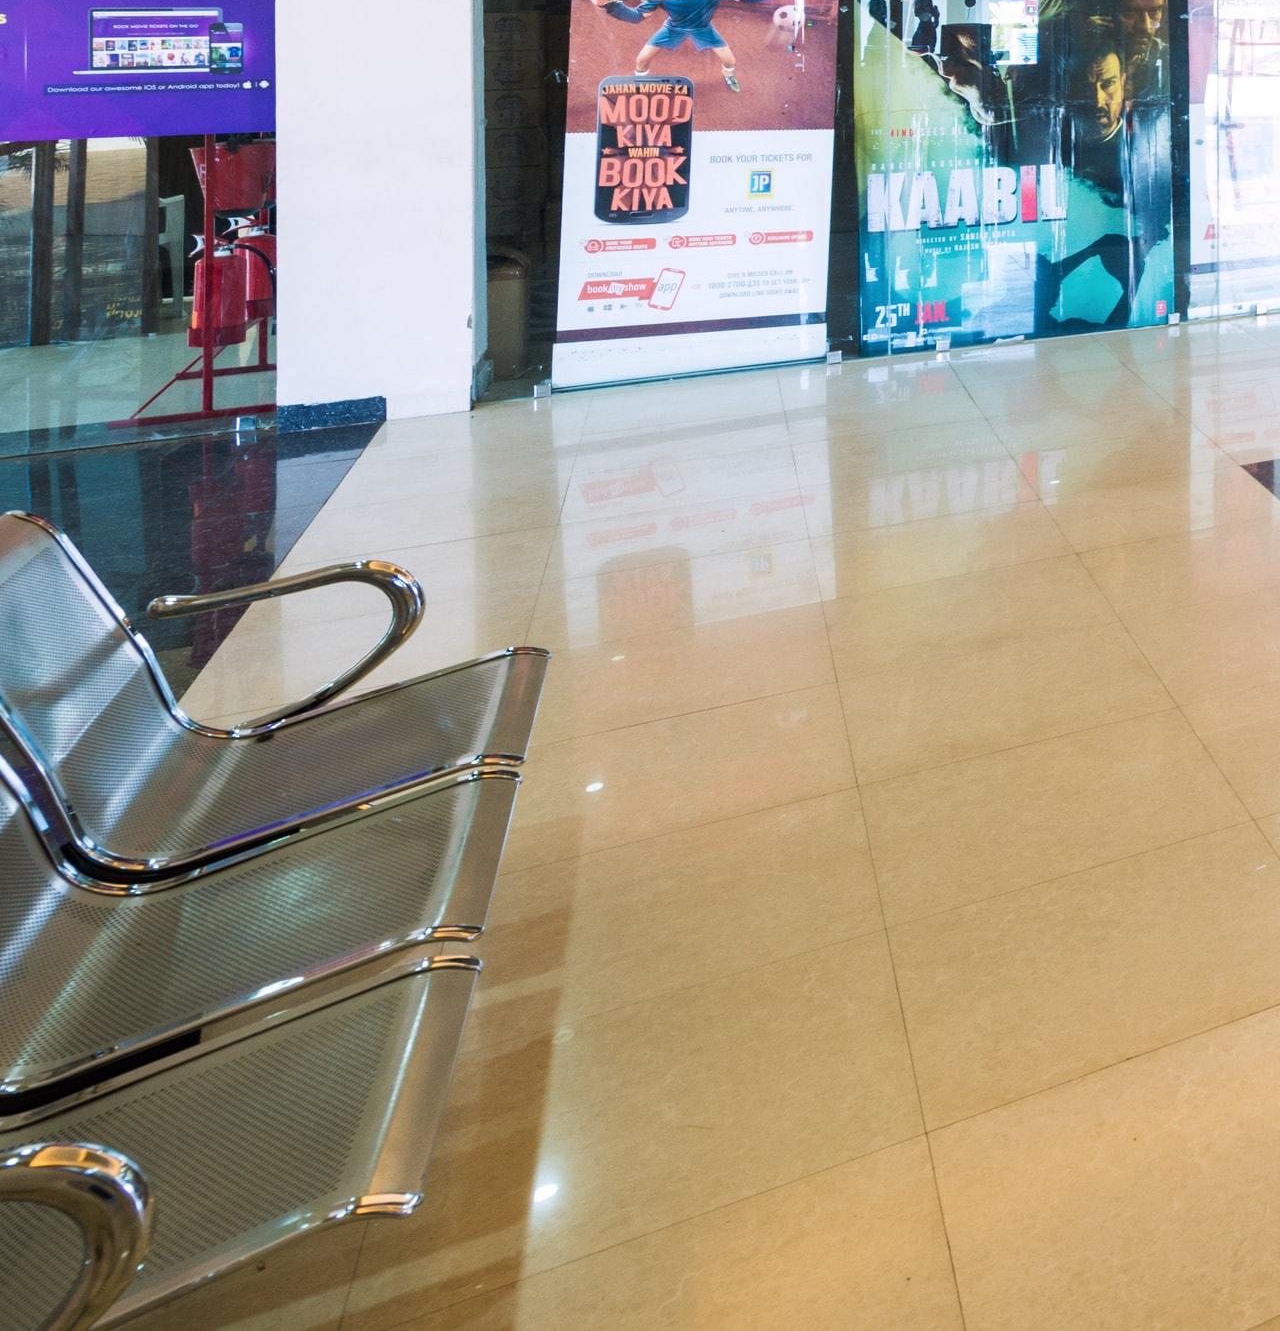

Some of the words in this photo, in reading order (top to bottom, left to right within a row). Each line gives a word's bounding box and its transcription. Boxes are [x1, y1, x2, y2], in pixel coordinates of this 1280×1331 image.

[47, 85, 89, 94] Download
[167, 82, 197, 90] Android
[216, 82, 240, 91] today!
[602, 84, 636, 95] JAHAN
[640, 83, 672, 94] MOVIE
[674, 84, 688, 95] KA
[600, 94, 693, 124] MOOD
[616, 124, 672, 148] KIYA
[628, 147, 660, 158] WAHIN
[709, 155, 733, 164] BOOK
[736, 154, 758, 163] YOUR
[760, 153, 794, 163] TICKETS
[796, 153, 812, 162] FOR
[598, 156, 688, 188] BOOK
[751, 175, 769, 191] JP
[610, 187, 674, 211] KIYA
[867, 164, 1068, 232] KAABIL
[657, 283, 677, 293] app
